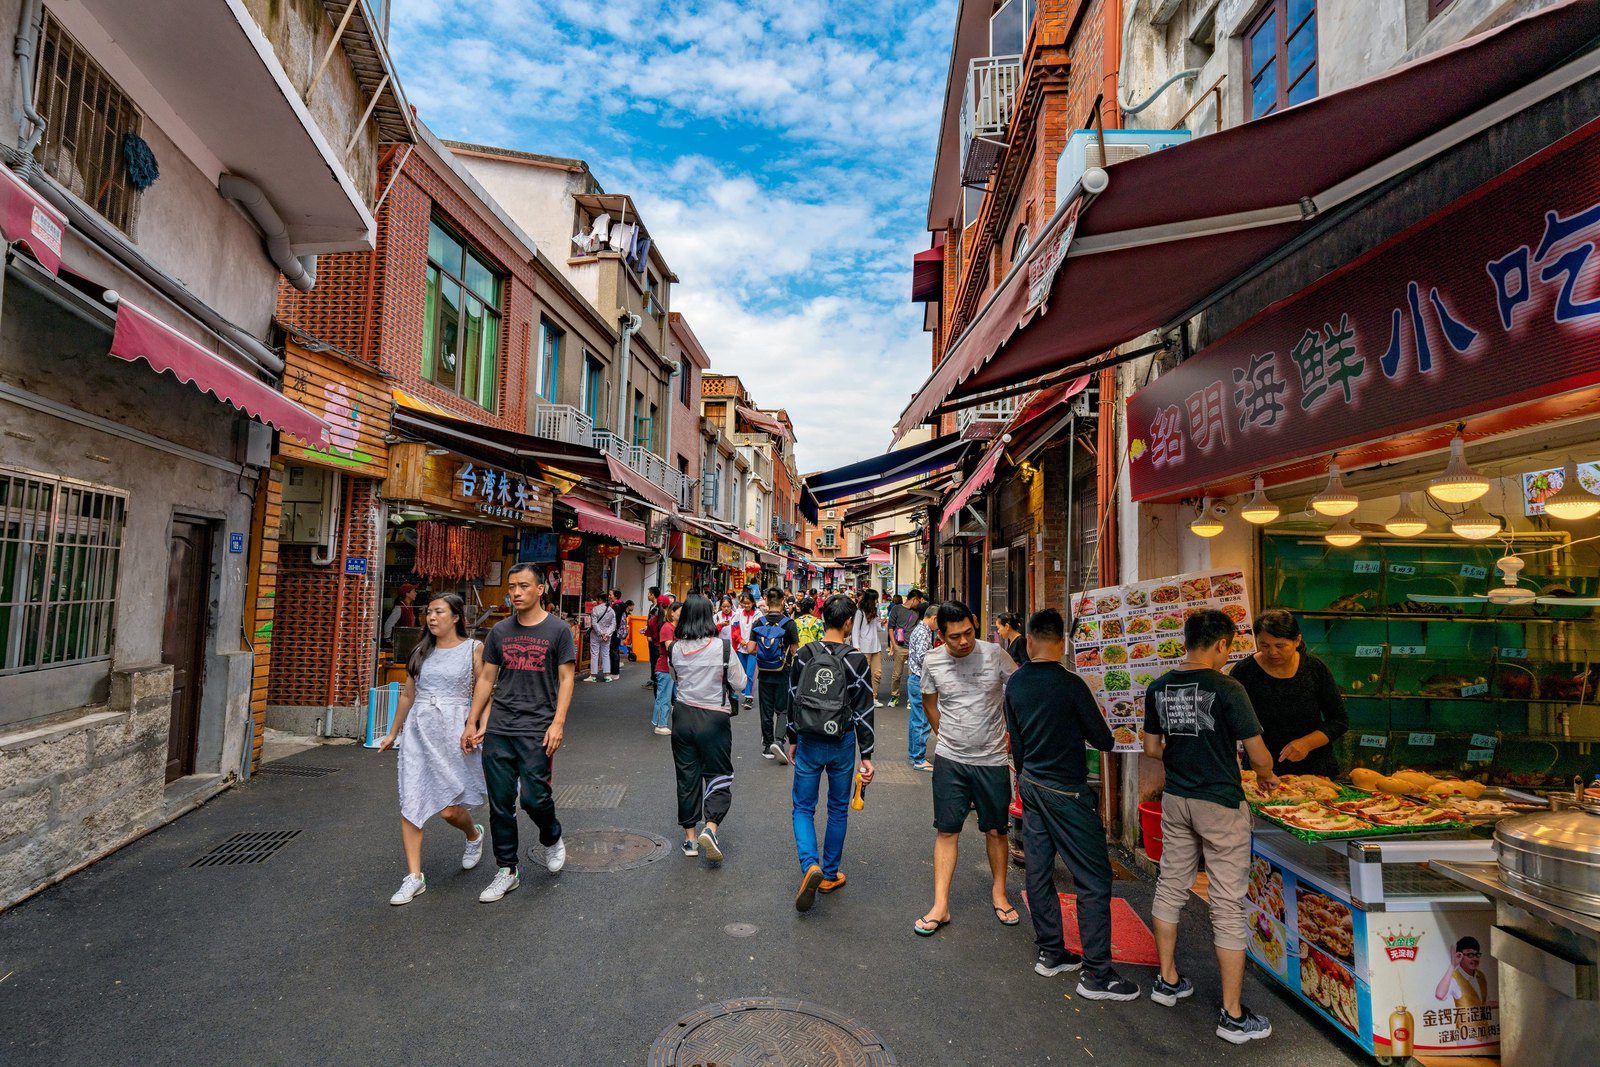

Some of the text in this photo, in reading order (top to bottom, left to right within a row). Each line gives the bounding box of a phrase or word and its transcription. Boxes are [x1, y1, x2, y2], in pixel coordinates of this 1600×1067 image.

[1151, 204, 1600, 465] 绍明海鲜小吃
[1423, 1006, 1492, 1027] 金锣无淀粉
